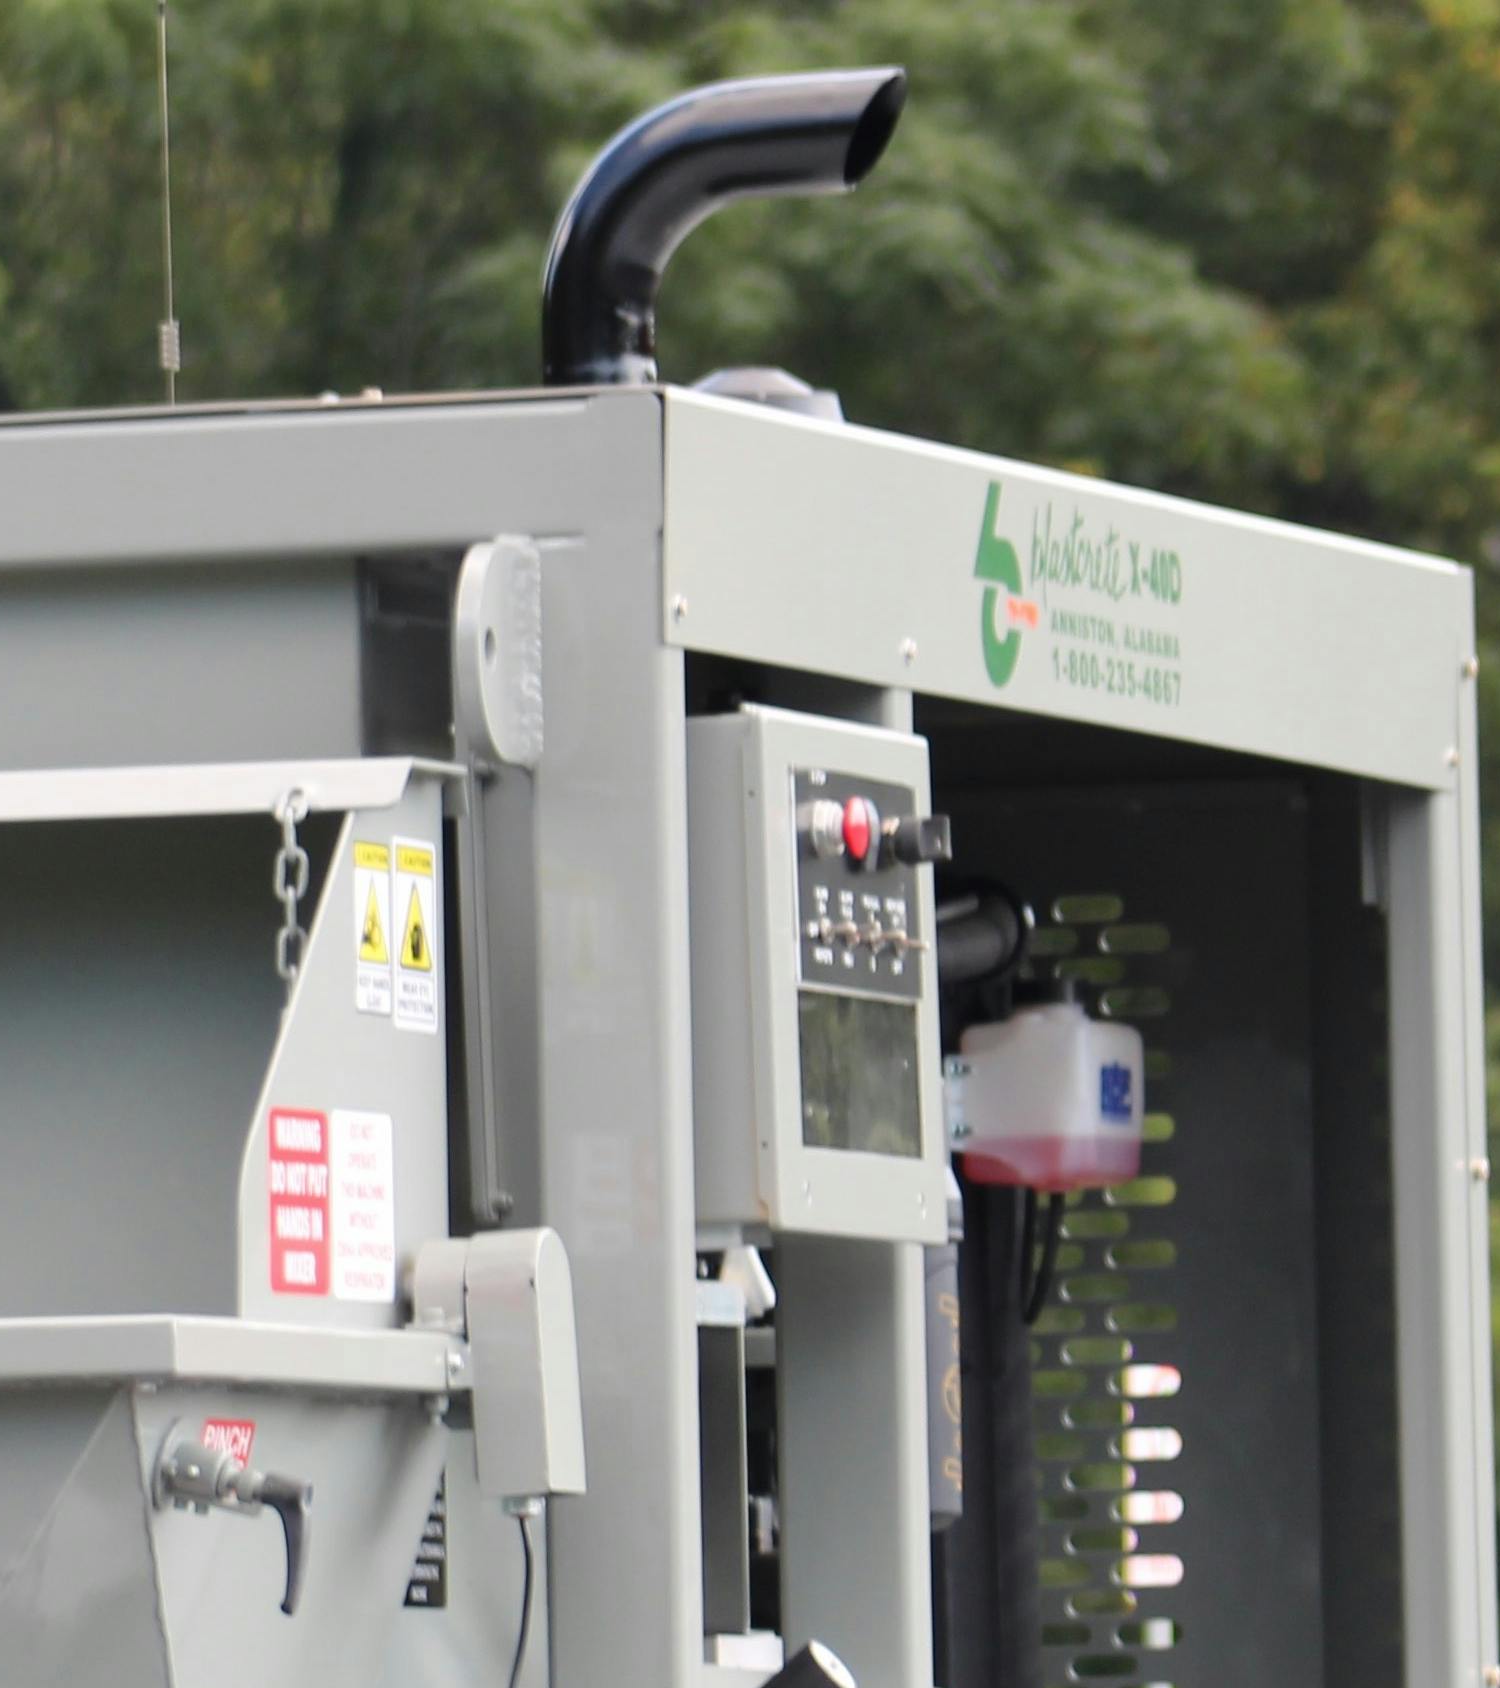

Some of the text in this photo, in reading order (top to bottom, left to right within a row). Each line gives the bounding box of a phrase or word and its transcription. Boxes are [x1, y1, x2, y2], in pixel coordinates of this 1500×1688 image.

[1030, 501, 1127, 612] blastcrete
[1123, 624, 1180, 660] ALABAMA
[1052, 647, 1181, 707] 1-800-235-4867
[276, 1117, 321, 1152] WARNING
[271, 1161, 328, 1198] DO NOT PUT
[277, 1206, 323, 1241] HANDS IN
[203, 1424, 251, 1456] PINCH
